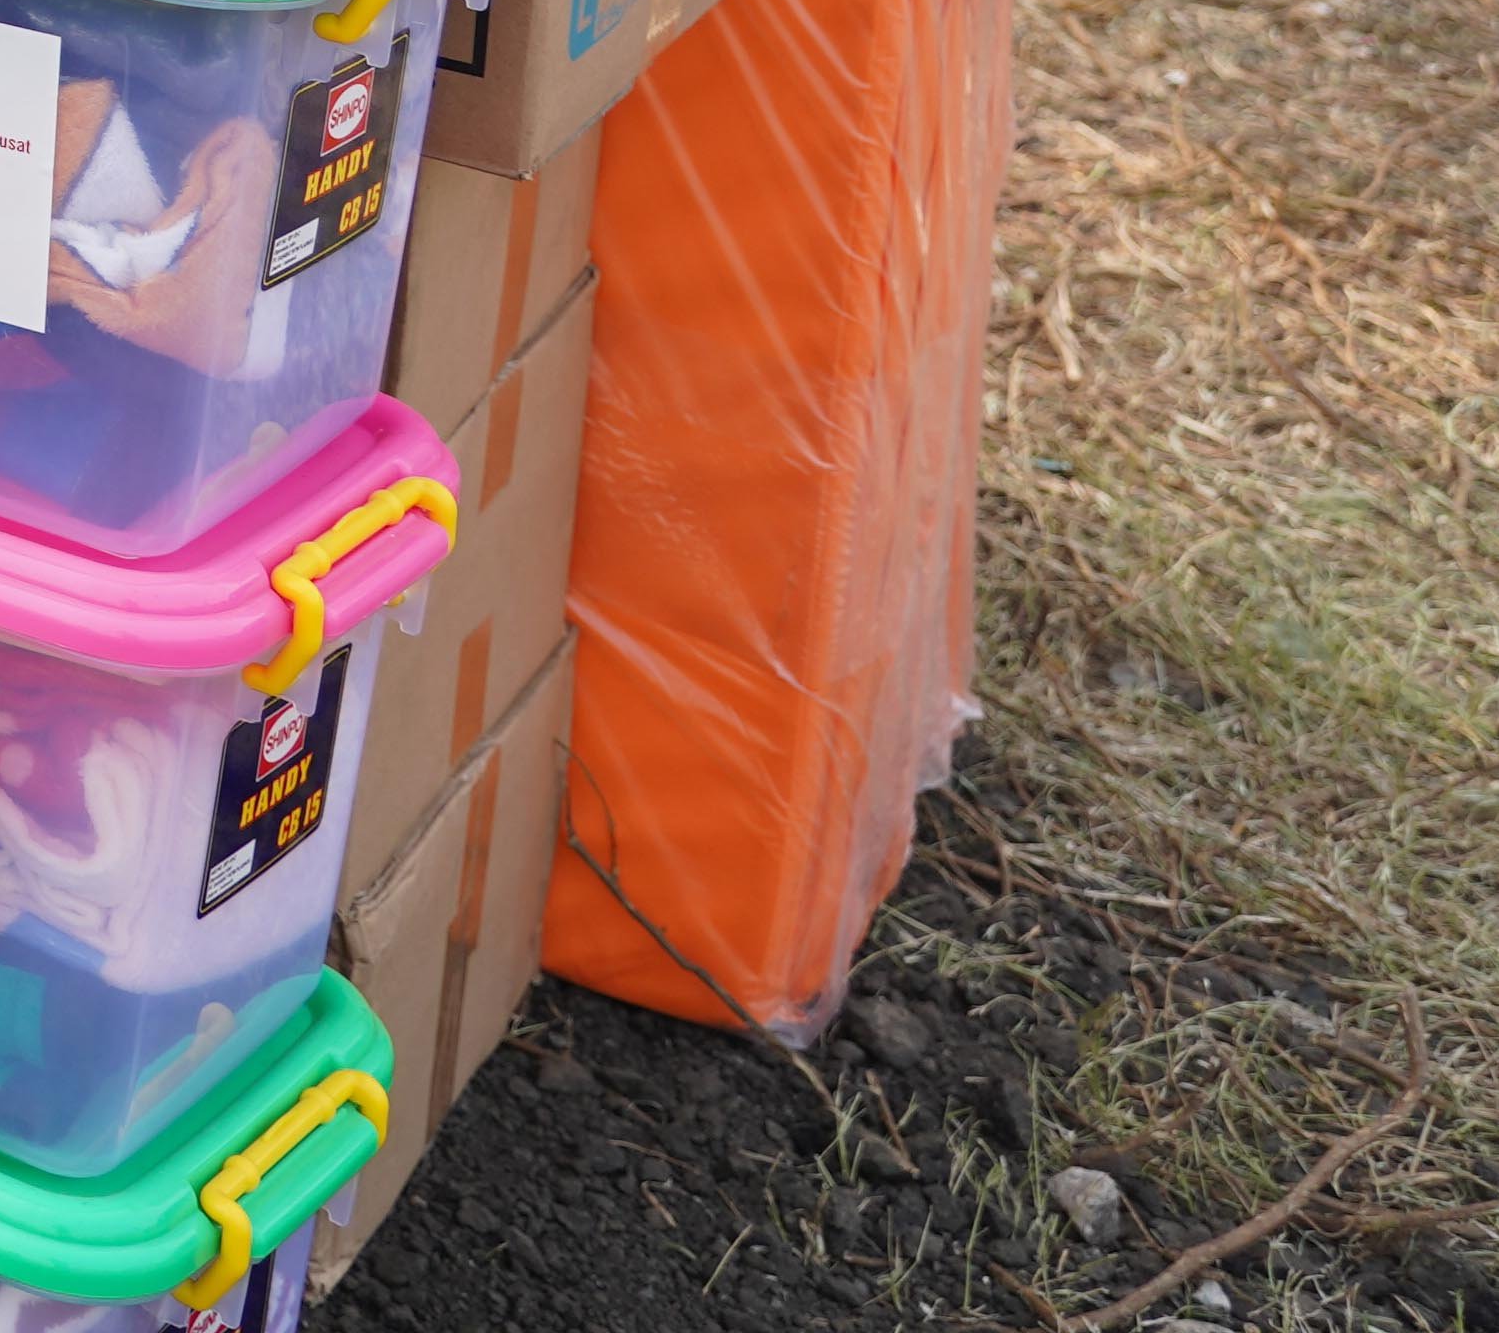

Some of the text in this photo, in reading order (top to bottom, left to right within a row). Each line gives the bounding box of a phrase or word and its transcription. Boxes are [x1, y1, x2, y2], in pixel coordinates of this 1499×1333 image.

[330, 95, 367, 128] SHINPO
[304, 141, 374, 202] HANDY
[340, 183, 382, 232] CB 15
[265, 716, 303, 754] SHINPO
[239, 754, 312, 830] HANDY
[277, 789, 322, 847] CB 15
